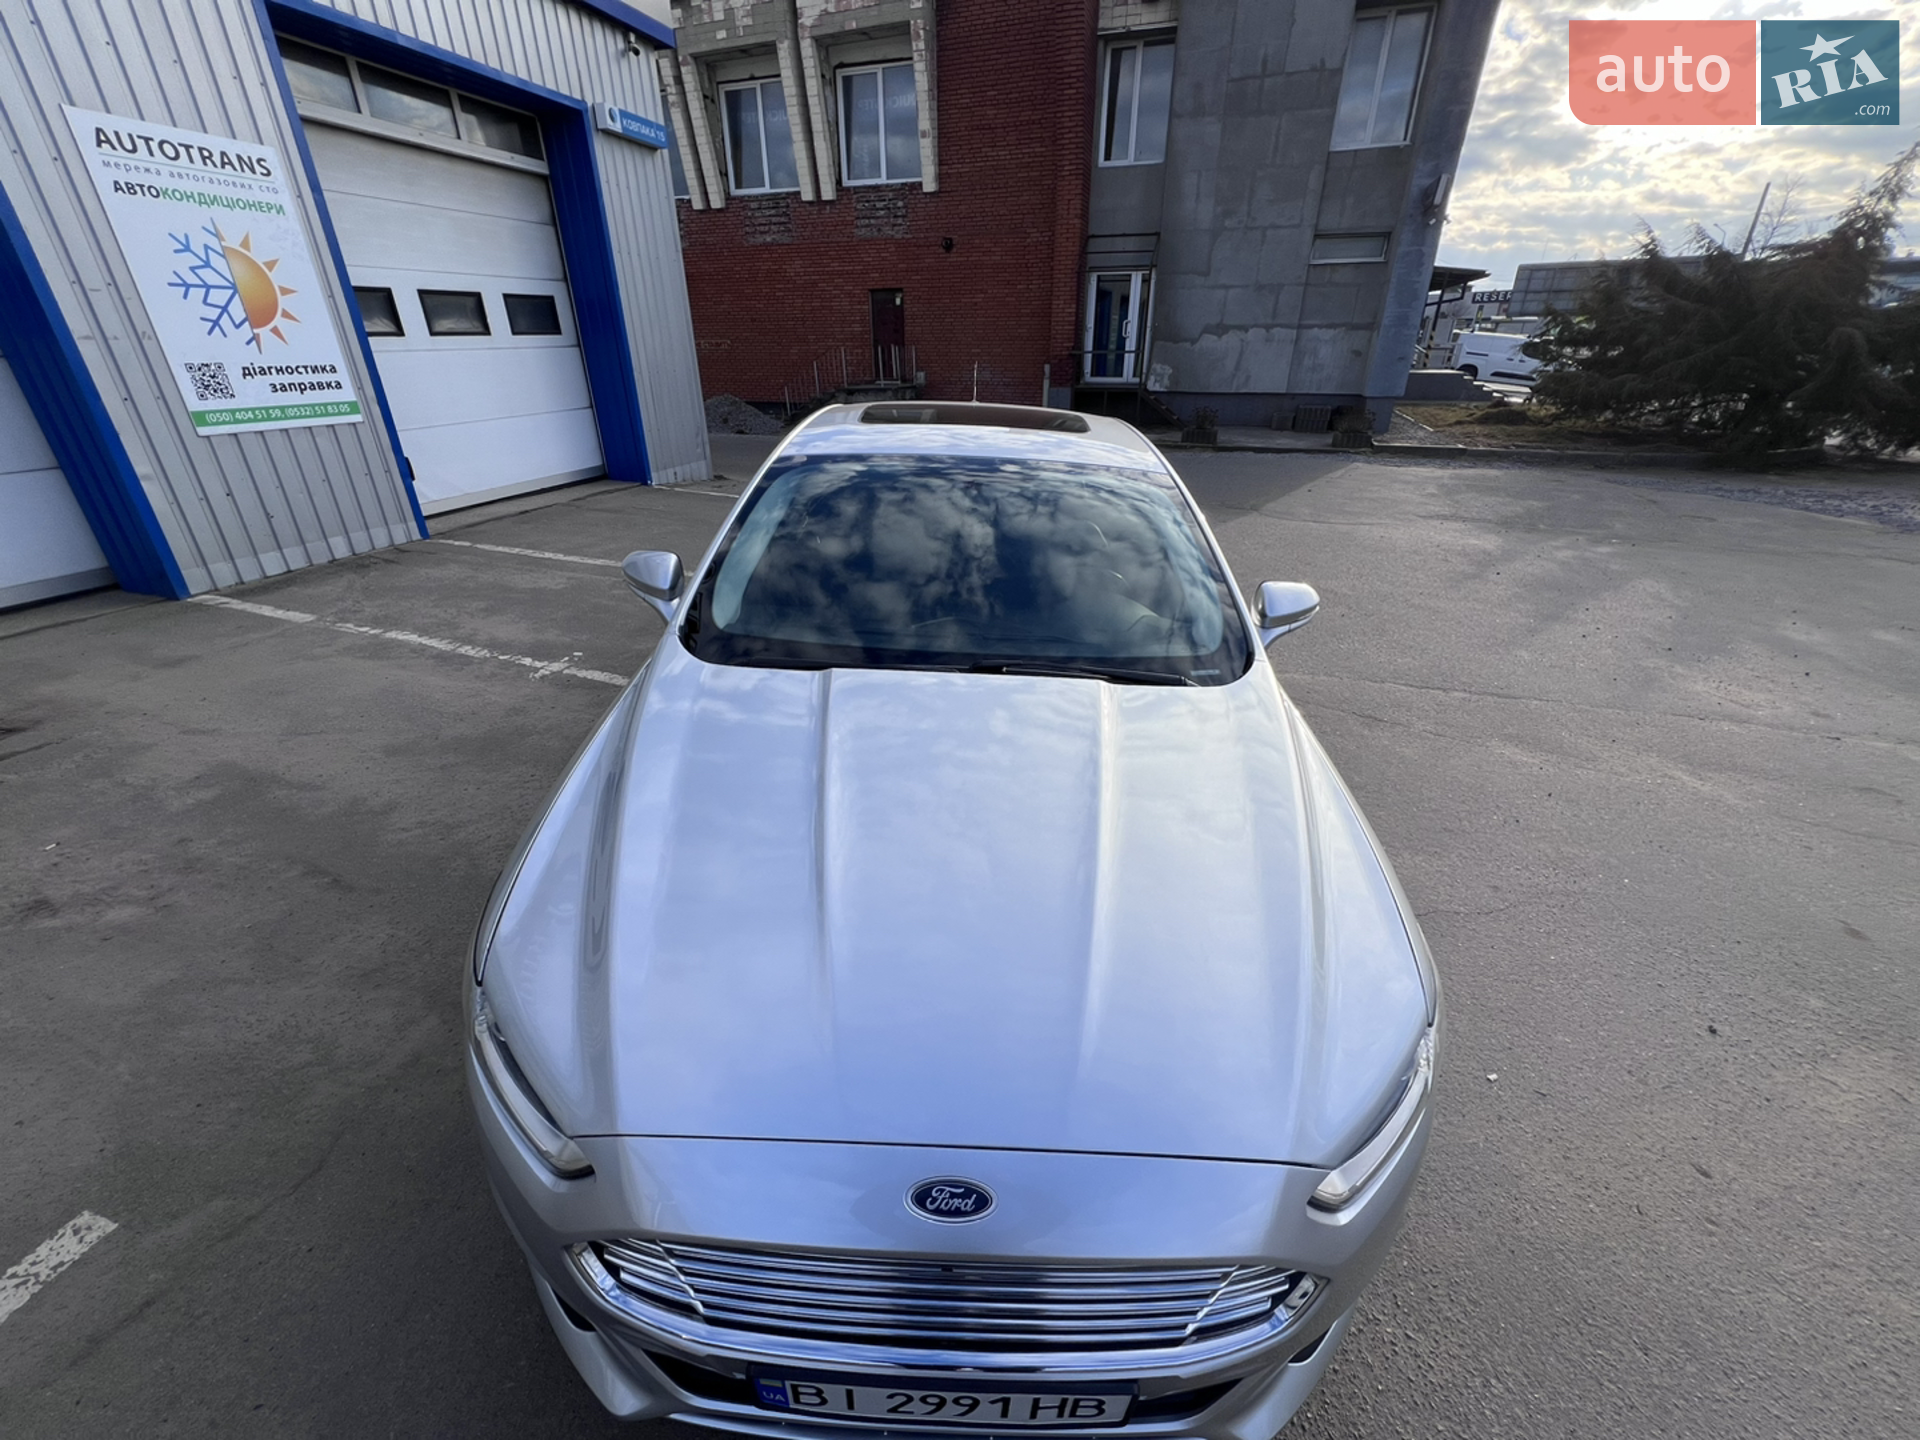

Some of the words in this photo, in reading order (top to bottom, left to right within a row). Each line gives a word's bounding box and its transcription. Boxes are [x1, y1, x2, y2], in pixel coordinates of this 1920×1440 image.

[94, 126, 272, 177] AUTOTRANS
[102, 160, 162, 176] мережа
[168, 170, 254, 191] автогазових
[114, 180, 286, 216] АВТОКОНДИЦІОНЕРИ
[241, 362, 338, 380] діагностика
[269, 380, 343, 395] заправка
[205, 411, 233, 424] (050)
[235, 410, 254, 420] 404
[256, 409, 267, 419] 51
[315, 405, 326, 414] 51
[327, 404, 338, 413] 83
[339, 403, 350, 413] 05
[925, 1186, 978, 1213] Ford
[762, 1390, 786, 1404] UA
[885, 1391, 1011, 1419] 2991
[1030, 1397, 1106, 1421] HB
